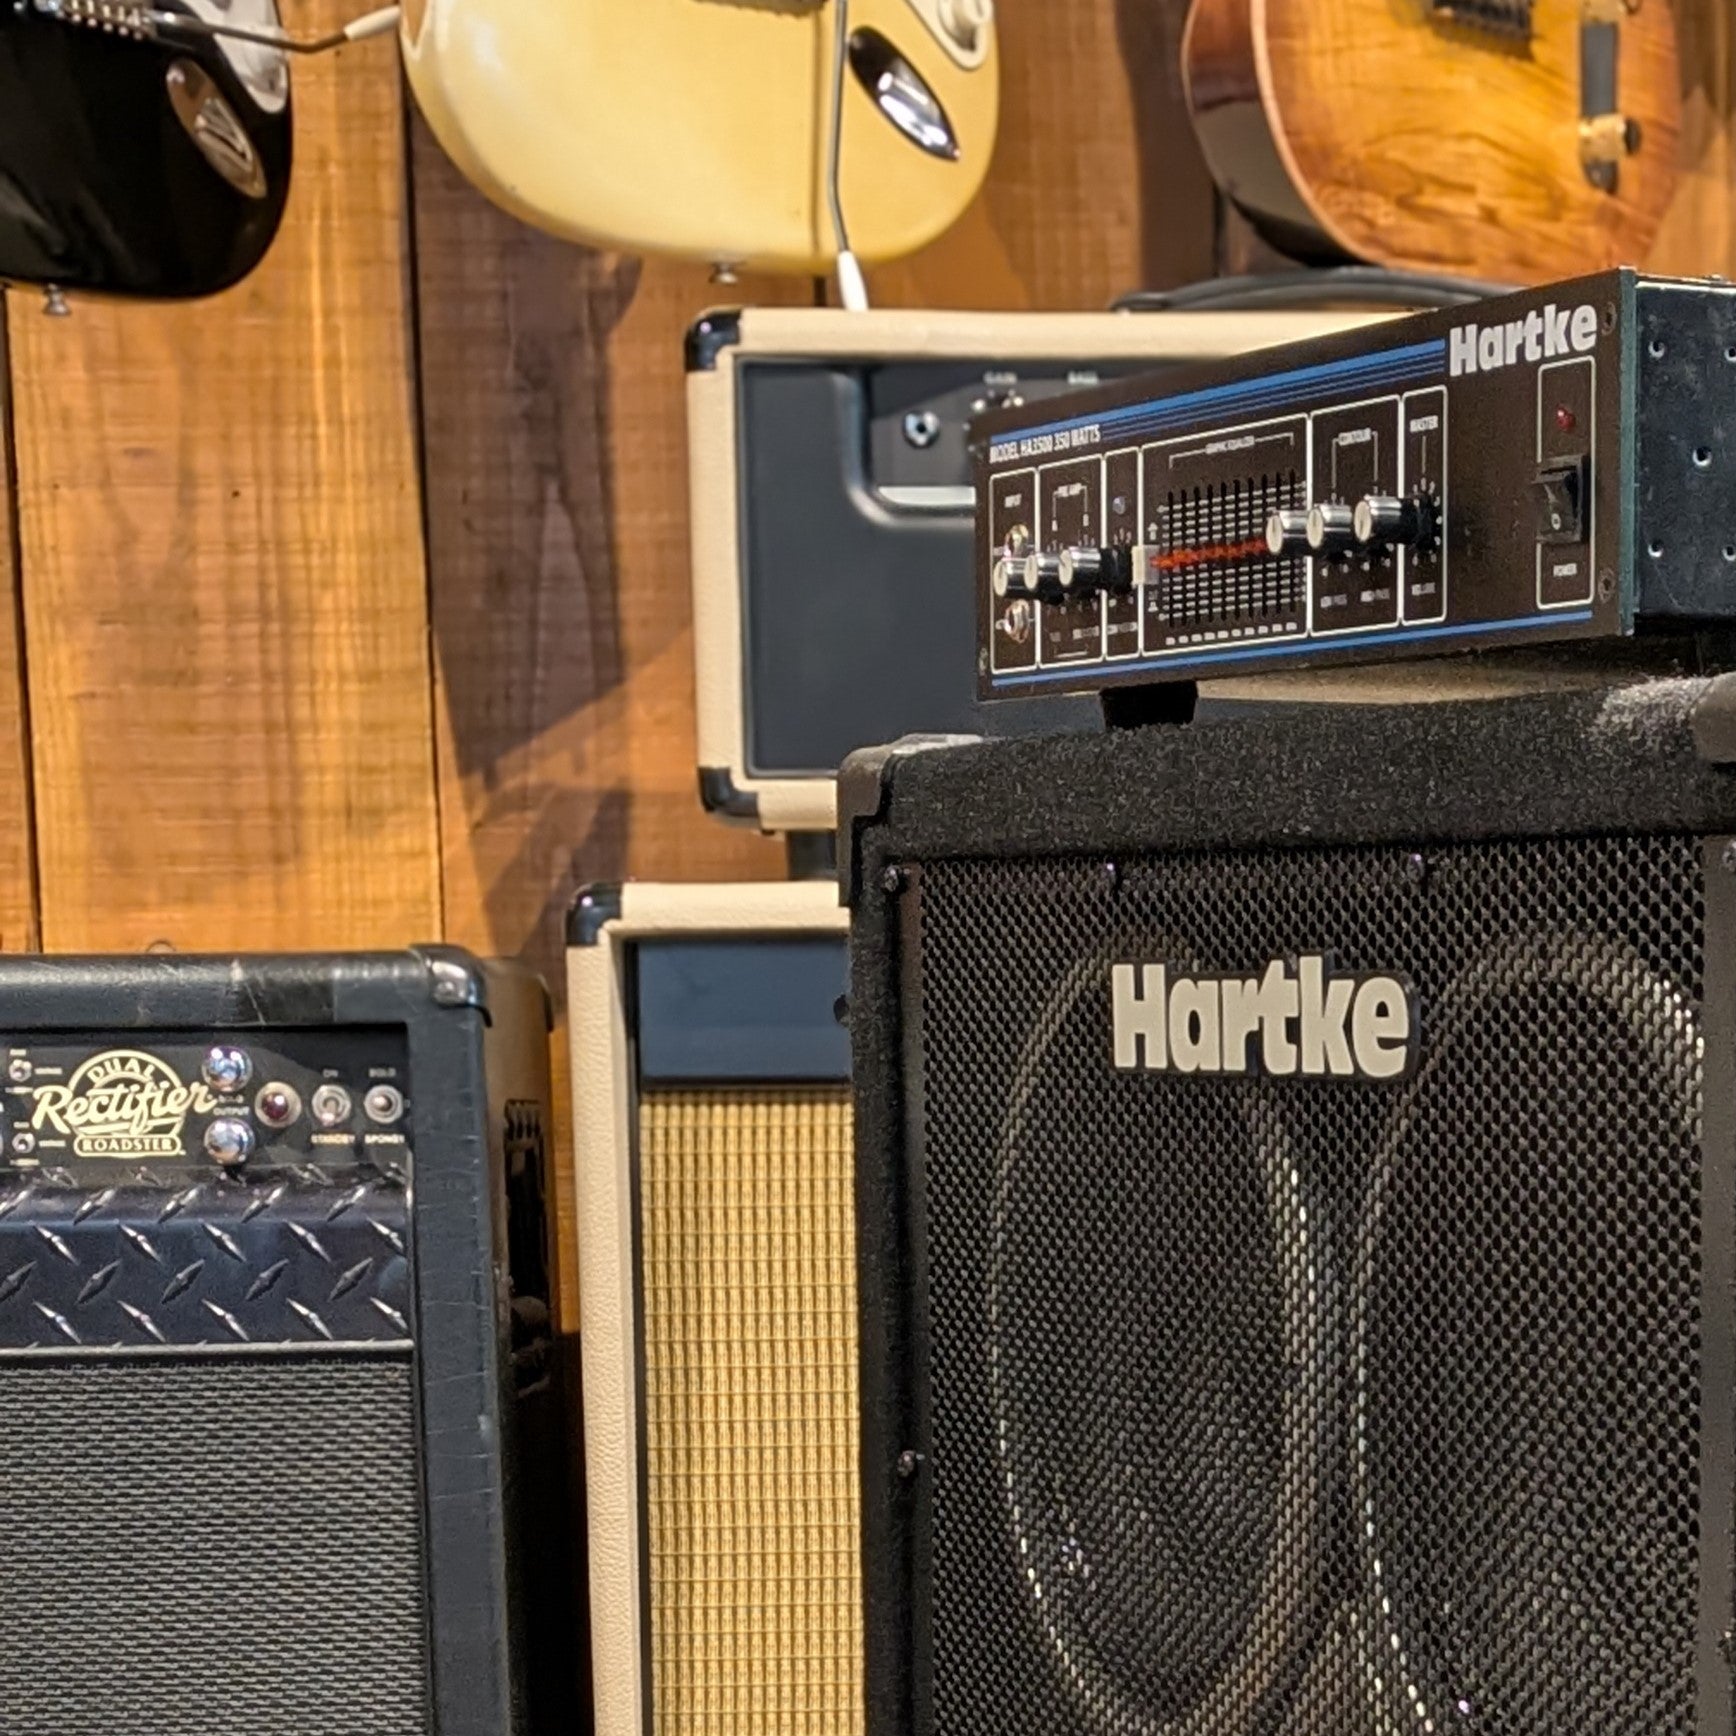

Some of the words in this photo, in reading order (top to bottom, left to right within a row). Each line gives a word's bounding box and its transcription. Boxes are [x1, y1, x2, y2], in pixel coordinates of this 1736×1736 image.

[1450, 304, 1598, 377] Hartke
[990, 441, 1019, 464] MODEL
[1071, 423, 1100, 447] WATTS
[1112, 956, 1409, 1077] Hartke
[87, 1057, 156, 1084] DUAL
[32, 1080, 218, 1135] Rectifier
[82, 1138, 173, 1151] ROADSTER
